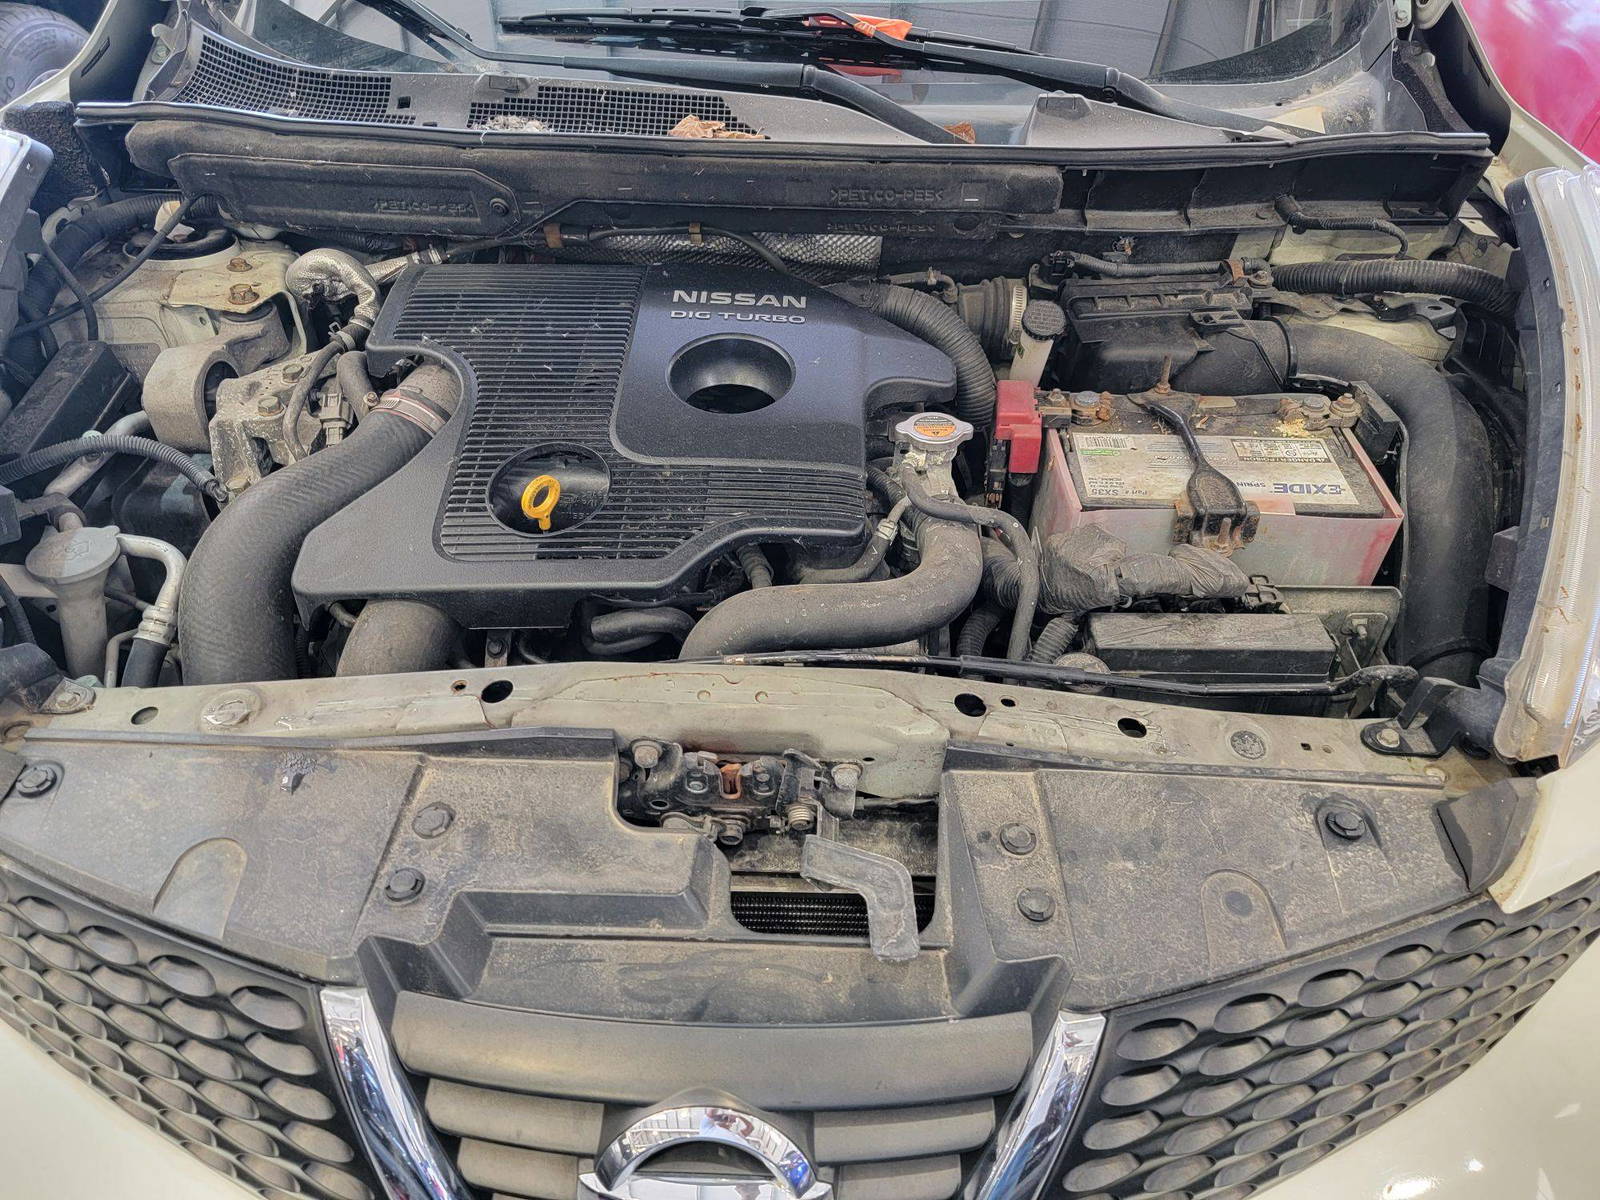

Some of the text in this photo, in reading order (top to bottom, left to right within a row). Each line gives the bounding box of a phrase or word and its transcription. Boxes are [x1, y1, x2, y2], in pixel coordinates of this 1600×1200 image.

[672, 289, 807, 309] NISSAN
[670, 310, 806, 324] DIG TURBO
[1091, 488, 1119, 496] SX35
[1273, 482, 1345, 495] EXIDE
